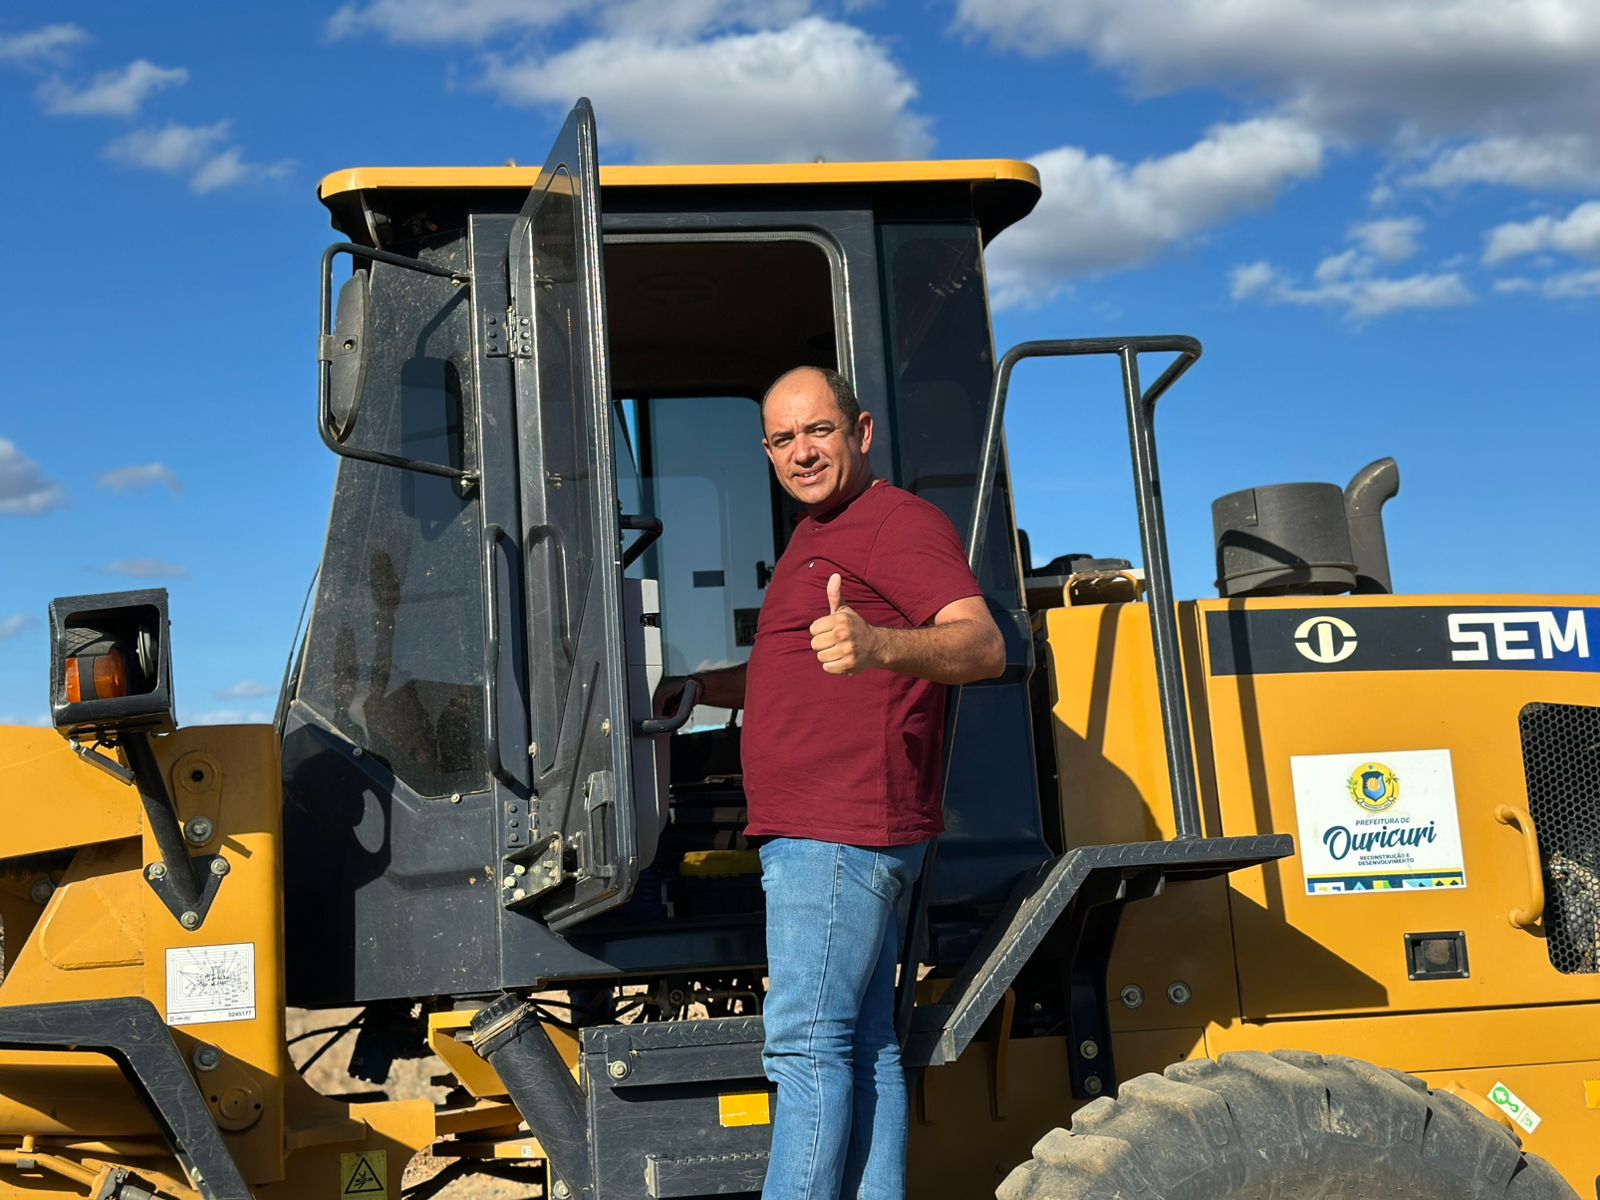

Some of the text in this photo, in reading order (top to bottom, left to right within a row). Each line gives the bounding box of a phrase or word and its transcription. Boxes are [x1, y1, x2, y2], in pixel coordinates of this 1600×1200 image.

[1447, 610, 1590, 661] SEM
[1355, 818, 1399, 826] PREFEITURA
[1323, 820, 1437, 861] Ouricuri
[1358, 858, 1415, 866] DESENVOLVIMENTO
[228, 1010, 252, 1018] 5245177
